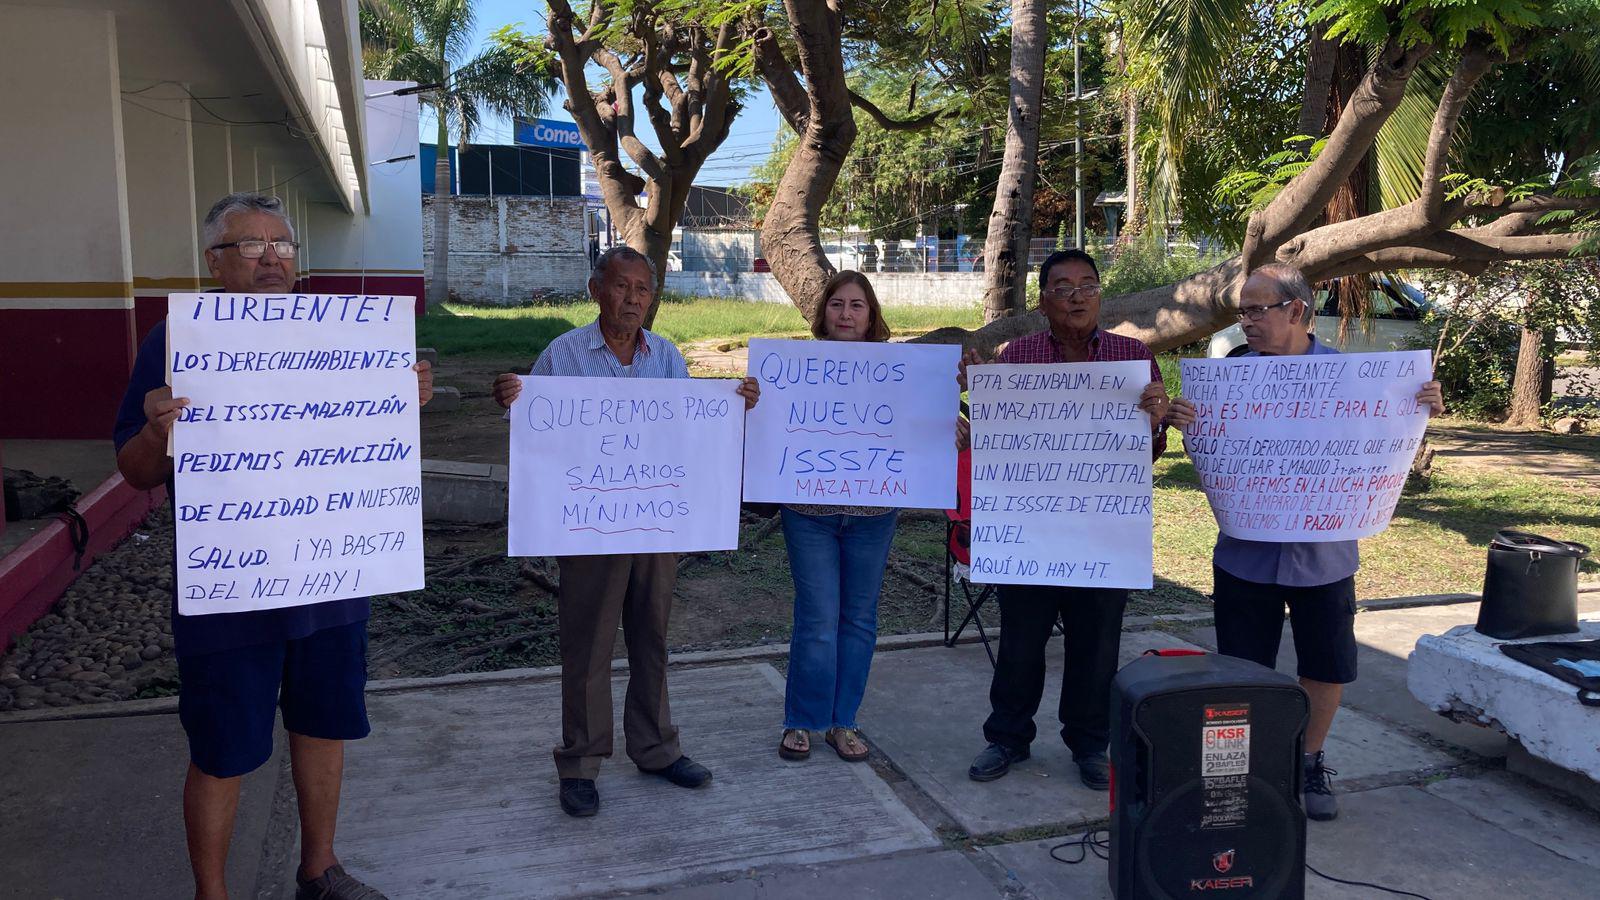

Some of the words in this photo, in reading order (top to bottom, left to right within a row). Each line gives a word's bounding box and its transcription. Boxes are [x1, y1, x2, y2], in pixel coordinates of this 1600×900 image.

[173, 351, 210, 372] LOS
[215, 350, 411, 372] DERECHOHABIENTES
[760, 352, 906, 390] QUEREMOS
[1359, 360, 1390, 379] QUE
[1397, 360, 1415, 378] LA
[1099, 375, 1127, 391] EN
[1227, 384, 1244, 401] ES
[178, 406, 217, 423] DEL
[528, 394, 674, 431] QUEREMOS
[683, 396, 729, 420] PAGO
[788, 401, 894, 425] NUEVO
[972, 403, 992, 421] EN
[994, 400, 1084, 421] MAZATLÁN
[1090, 402, 1139, 421] URGE
[1220, 403, 1238, 420] ES
[1333, 400, 1367, 418] PARA
[1373, 400, 1389, 418] EL
[1396, 398, 1422, 417] QUE
[600, 433, 640, 456] EN
[1127, 434, 1150, 452] DE
[1221, 436, 1253, 456] ESTÁ
[1252, 439, 1320, 457] DERROTADO
[1321, 439, 1360, 457] AQUEL
[1363, 439, 1386, 455] QUE
[1389, 438, 1404, 453] HA
[178, 451, 284, 473] PEDIMOS
[295, 438, 412, 468] ATENCIÓN
[779, 446, 905, 476] ISSSTE
[566, 464, 686, 486] SALARIOS
[974, 463, 998, 481] UN
[1002, 463, 1062, 482] NUEVO
[1066, 462, 1147, 485] HOSPITAL
[1212, 458, 1226, 474] DE
[1227, 458, 1275, 475] LUCHAR
[796, 476, 908, 498] MAZATLÁN
[1203, 473, 1292, 494] CLAUDICAREMOS
[1293, 477, 1311, 494] EN
[1310, 477, 1326, 494] LA
[1328, 476, 1366, 494] LUCHA
[179, 504, 213, 522] DE
[218, 495, 319, 522] CALIDAD
[326, 492, 354, 511] EN
[357, 486, 421, 509] NUESTRA
[562, 495, 690, 525] MÍNIMOS
[970, 495, 998, 512] DEL
[1067, 496, 1091, 513] DE
[1094, 495, 1151, 516] TERCER
[1252, 494, 1299, 512] AMPARO
[1299, 494, 1317, 512] DE
[1317, 495, 1332, 512] LA
[1366, 493, 1377, 510] Y
[1234, 511, 1281, 530] TENEMOS
[1285, 514, 1300, 532] LA
[1303, 512, 1346, 532] RAZÓN
[1348, 513, 1358, 529] Y
[187, 546, 270, 569] SALUD.
[341, 531, 405, 556] BASTA
[972, 556, 1012, 575] AQUÍ
[1016, 560, 1039, 576] NO
[1045, 562, 1077, 578] HAY
[186, 581, 240, 600] DEL
[251, 577, 290, 598] NO
[1216, 728, 1246, 740] KSR
[1217, 738, 1246, 750] LINK
[1205, 751, 1247, 762] ENLAZA
[1206, 761, 1216, 774] 2
[1190, 876, 1254, 891] KAISER
